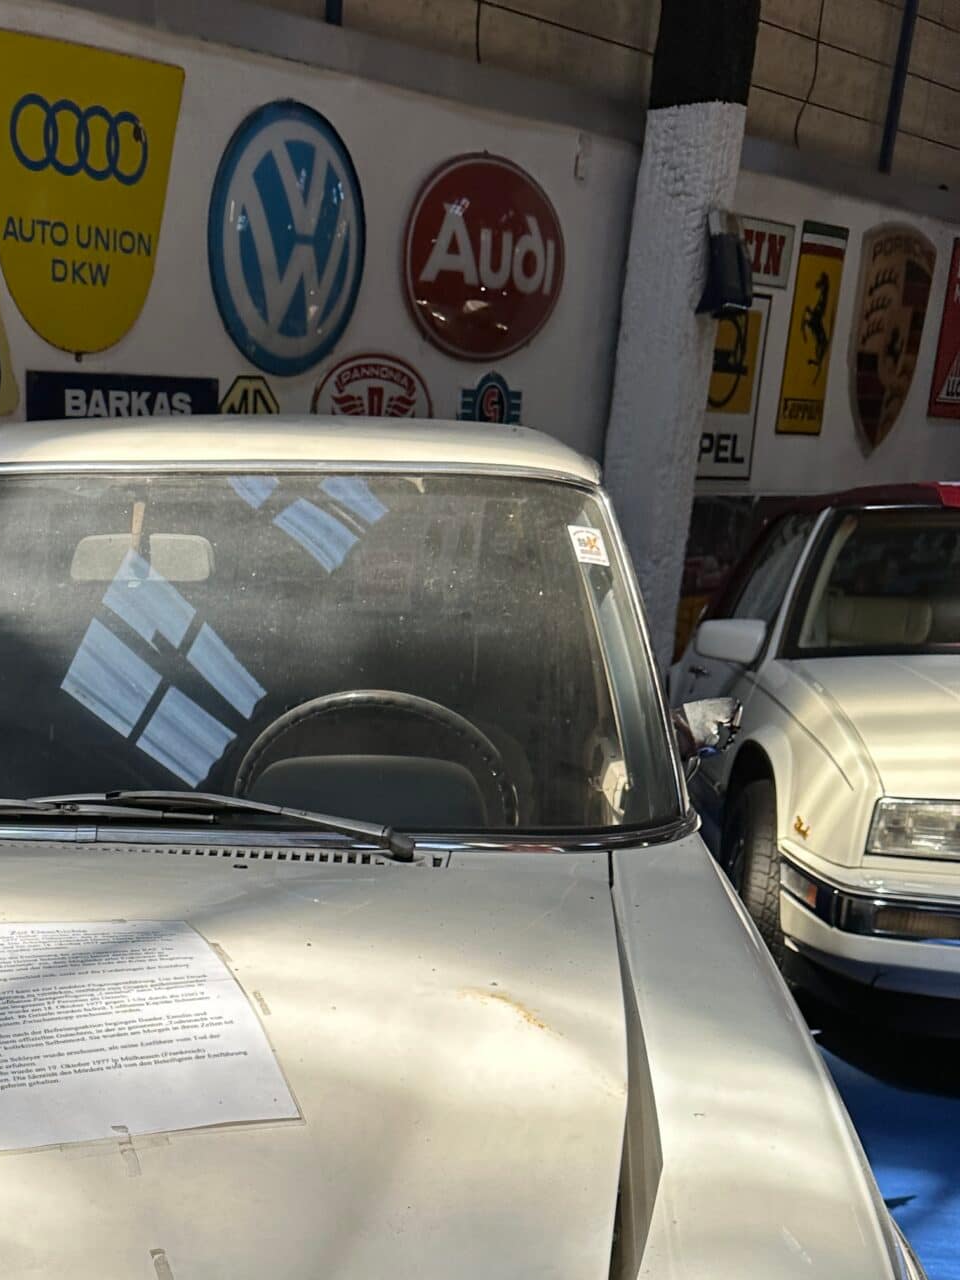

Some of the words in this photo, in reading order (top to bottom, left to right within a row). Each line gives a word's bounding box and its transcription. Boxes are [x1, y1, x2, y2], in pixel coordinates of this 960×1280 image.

[3, 216, 68, 246] AUTO
[77, 225, 152, 257] UNION
[233, 132, 352, 348] VW
[51, 259, 110, 288] DKW
[340, 367, 409, 390] PANNONIA
[65, 388, 192, 418] BARKAS
[697, 432, 745, 464] PEL
